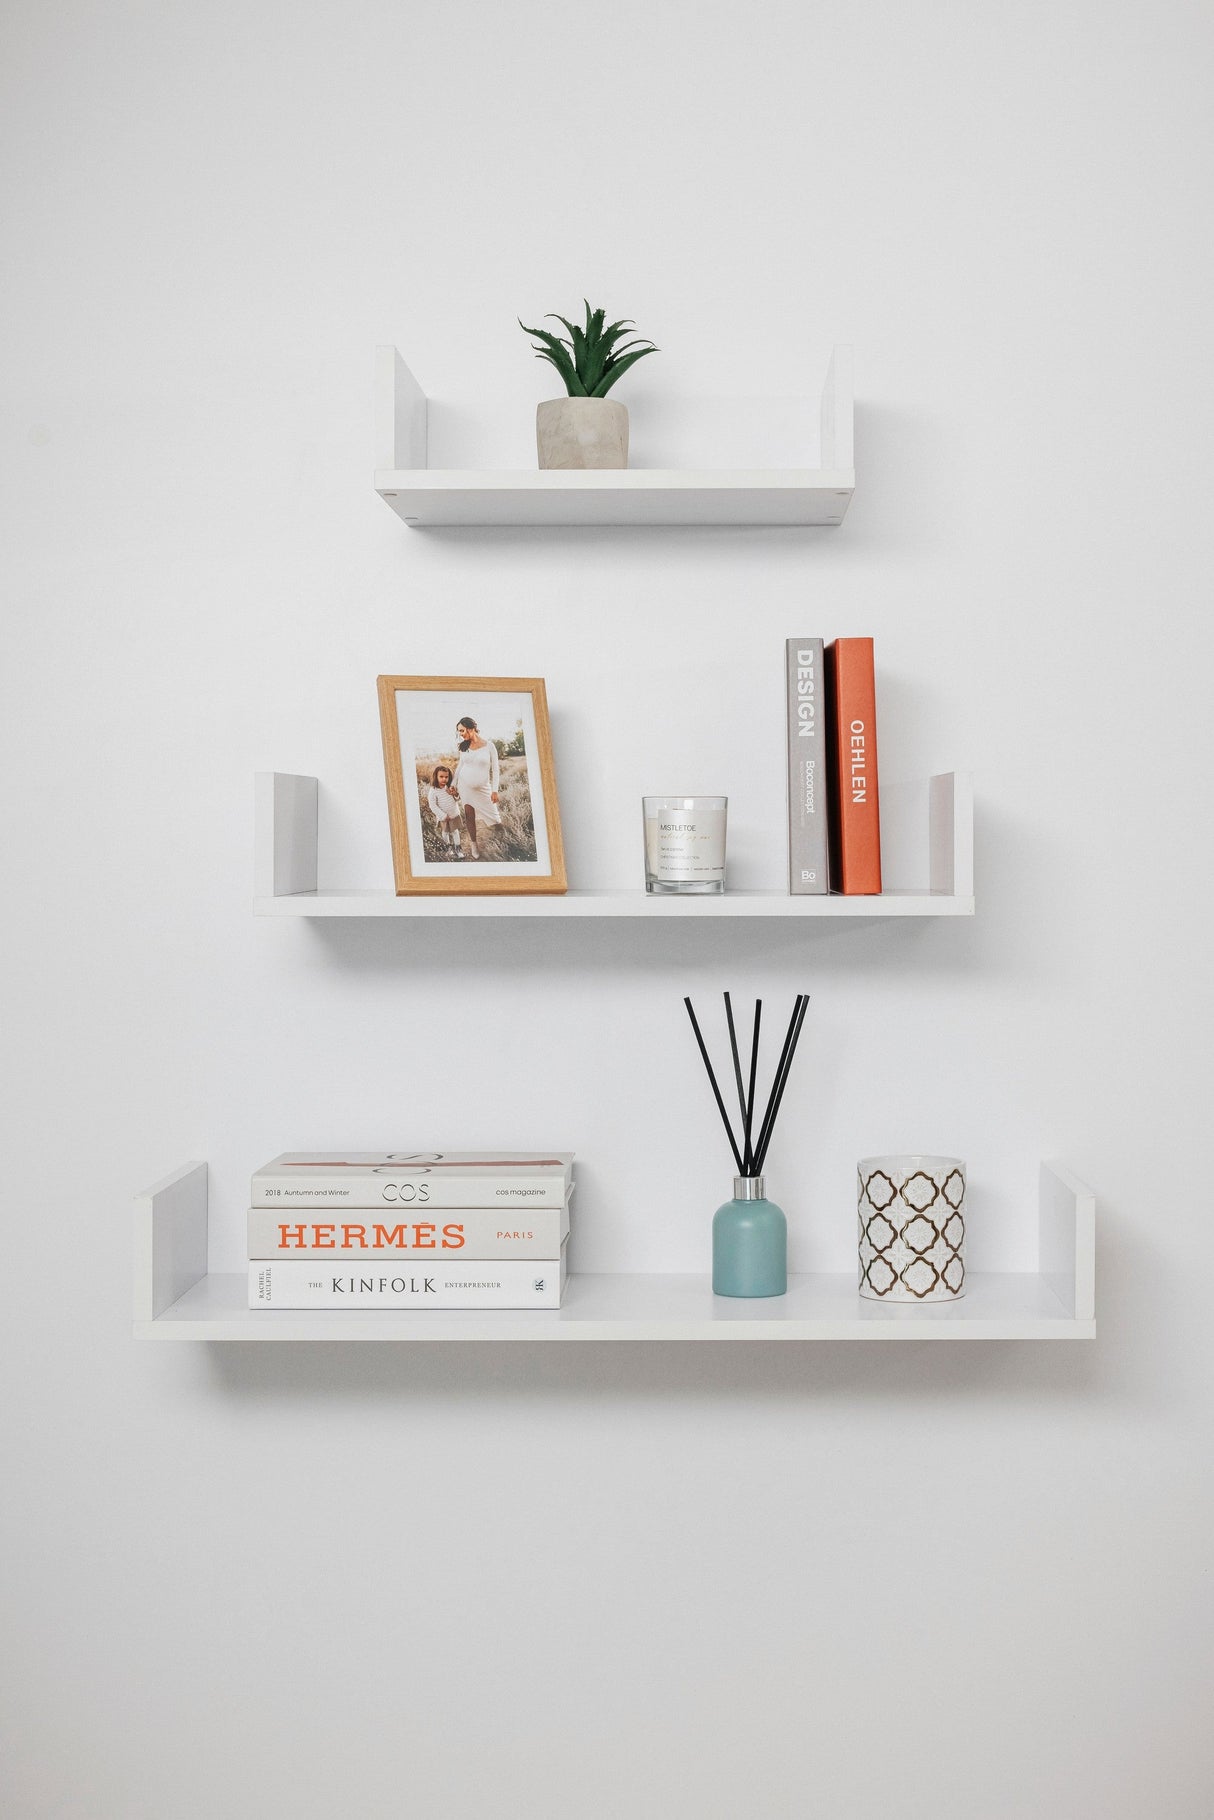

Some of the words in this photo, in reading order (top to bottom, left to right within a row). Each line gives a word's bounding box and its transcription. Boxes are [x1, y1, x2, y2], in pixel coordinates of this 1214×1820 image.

[796, 649, 815, 738] DESIGN
[850, 719, 867, 803] OEHLEN
[805, 760, 816, 814] Boconcept
[660, 824, 697, 832] MISTLETOE
[801, 870, 816, 880] Bo
[265, 1189, 282, 1197] 2018
[314, 1189, 328, 1197] and
[328, 1189, 350, 1197] Winter
[382, 1183, 431, 1202] COS
[495, 1189, 510, 1197] cos
[509, 1189, 546, 1198] magazine
[496, 1231, 534, 1239] PARIS
[308, 1281, 323, 1289] THE
[332, 1277, 437, 1293] KINFOLK
[444, 1281, 502, 1289] ENTERPRENEUR
